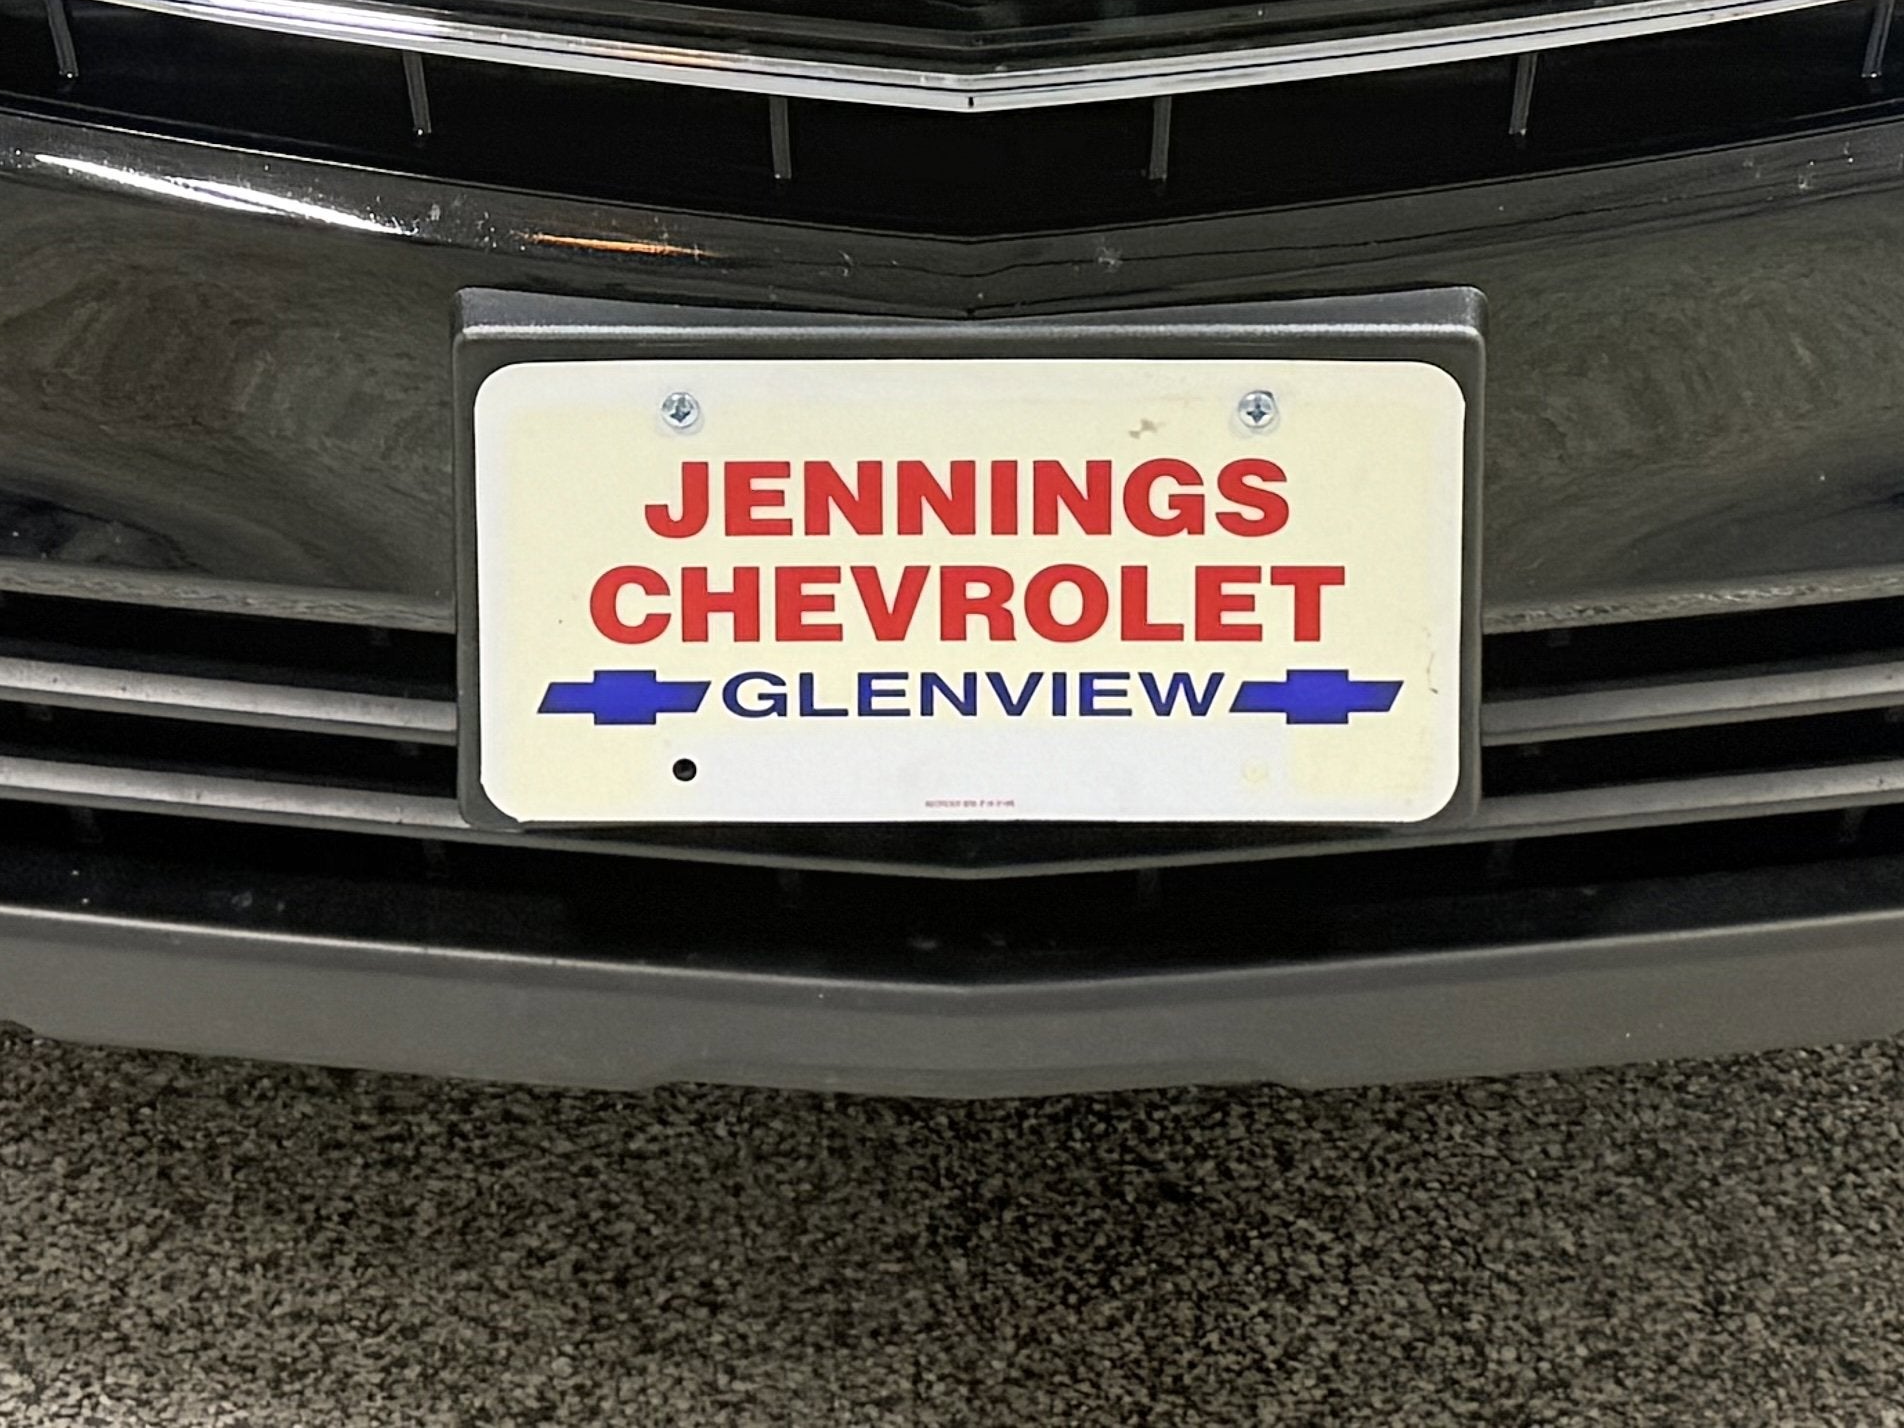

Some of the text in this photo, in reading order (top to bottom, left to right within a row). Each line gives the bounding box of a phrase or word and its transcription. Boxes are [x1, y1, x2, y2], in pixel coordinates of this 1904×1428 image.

[644, 458, 1290, 538] JENNINGS
[589, 563, 1346, 644] CHEVROLET
[722, 671, 1226, 718] GLENVIEW
